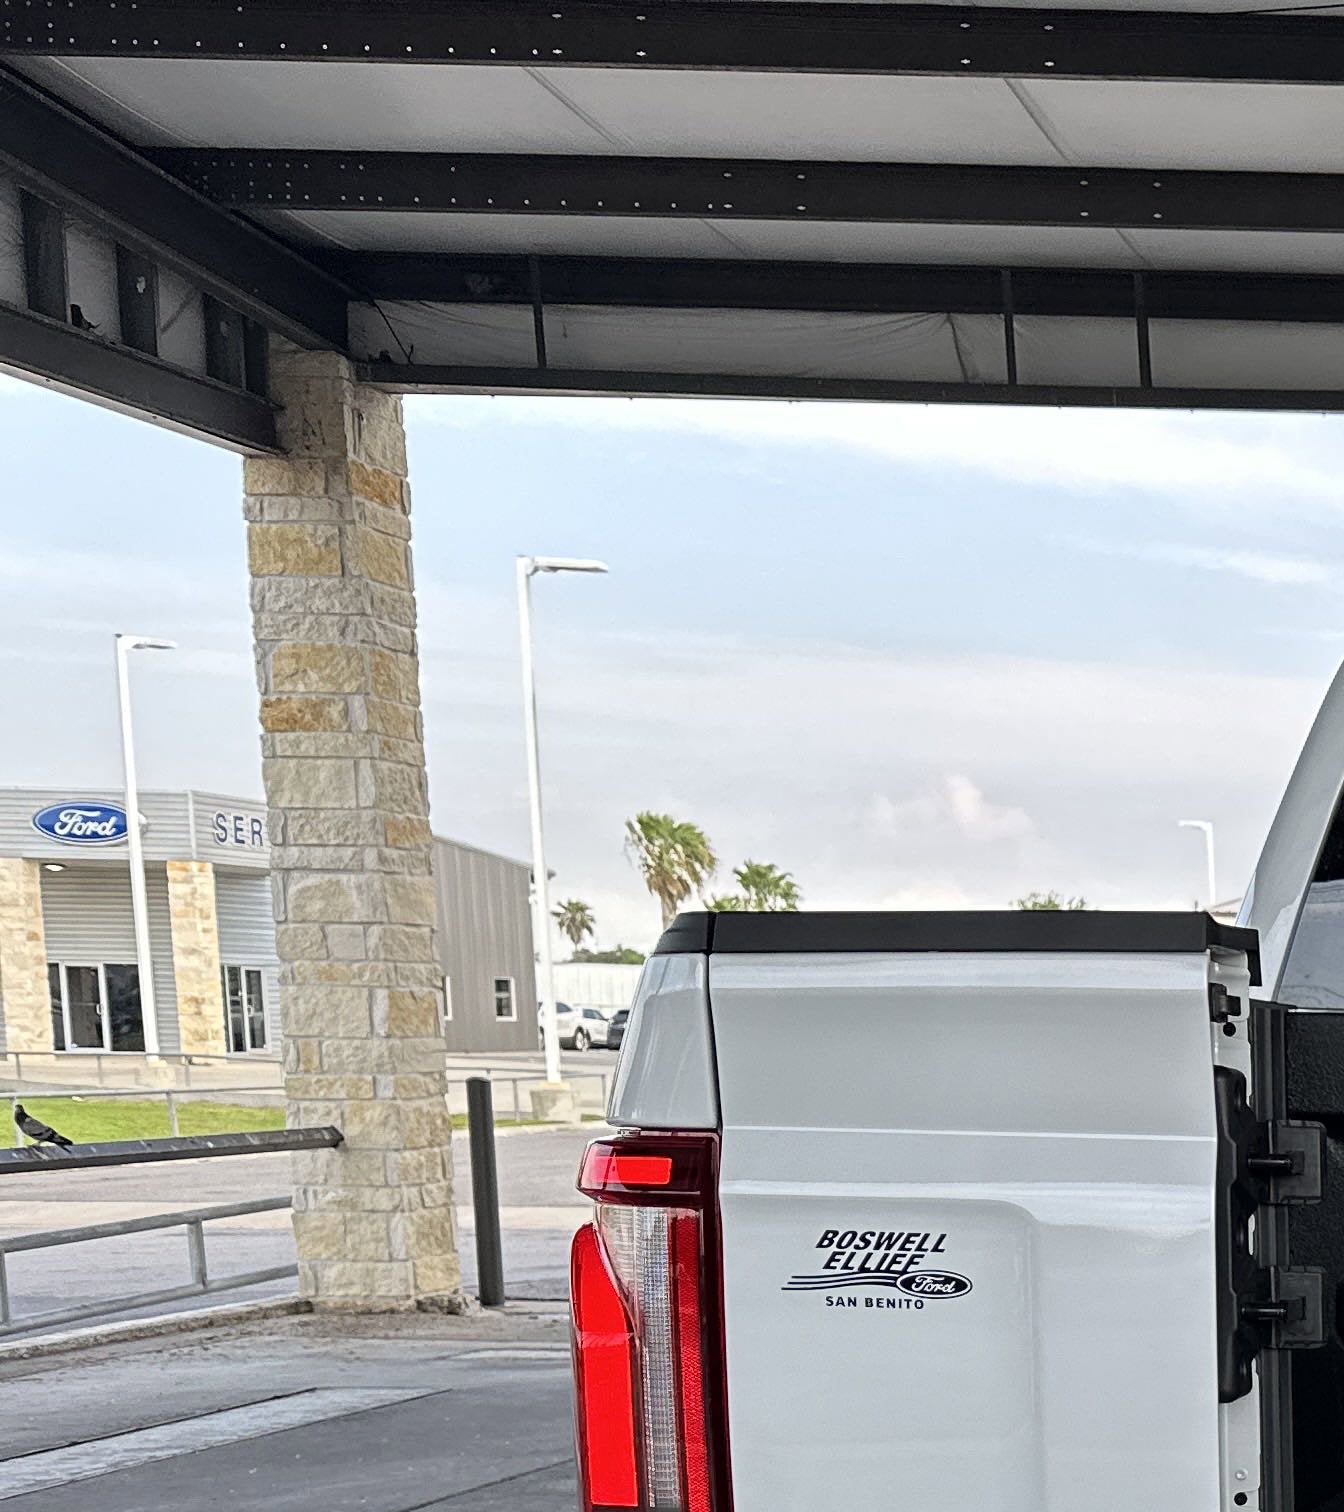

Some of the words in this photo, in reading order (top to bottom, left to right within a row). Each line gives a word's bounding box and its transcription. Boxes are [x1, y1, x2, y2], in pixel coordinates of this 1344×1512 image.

[53, 808, 118, 838] Ford
[815, 1229, 948, 1253] BOSWELL
[822, 1251, 926, 1273] ELLIFF
[911, 1275, 956, 1294] Ford
[825, 1295, 858, 1308] SAN
[864, 1297, 925, 1310] BENITO
